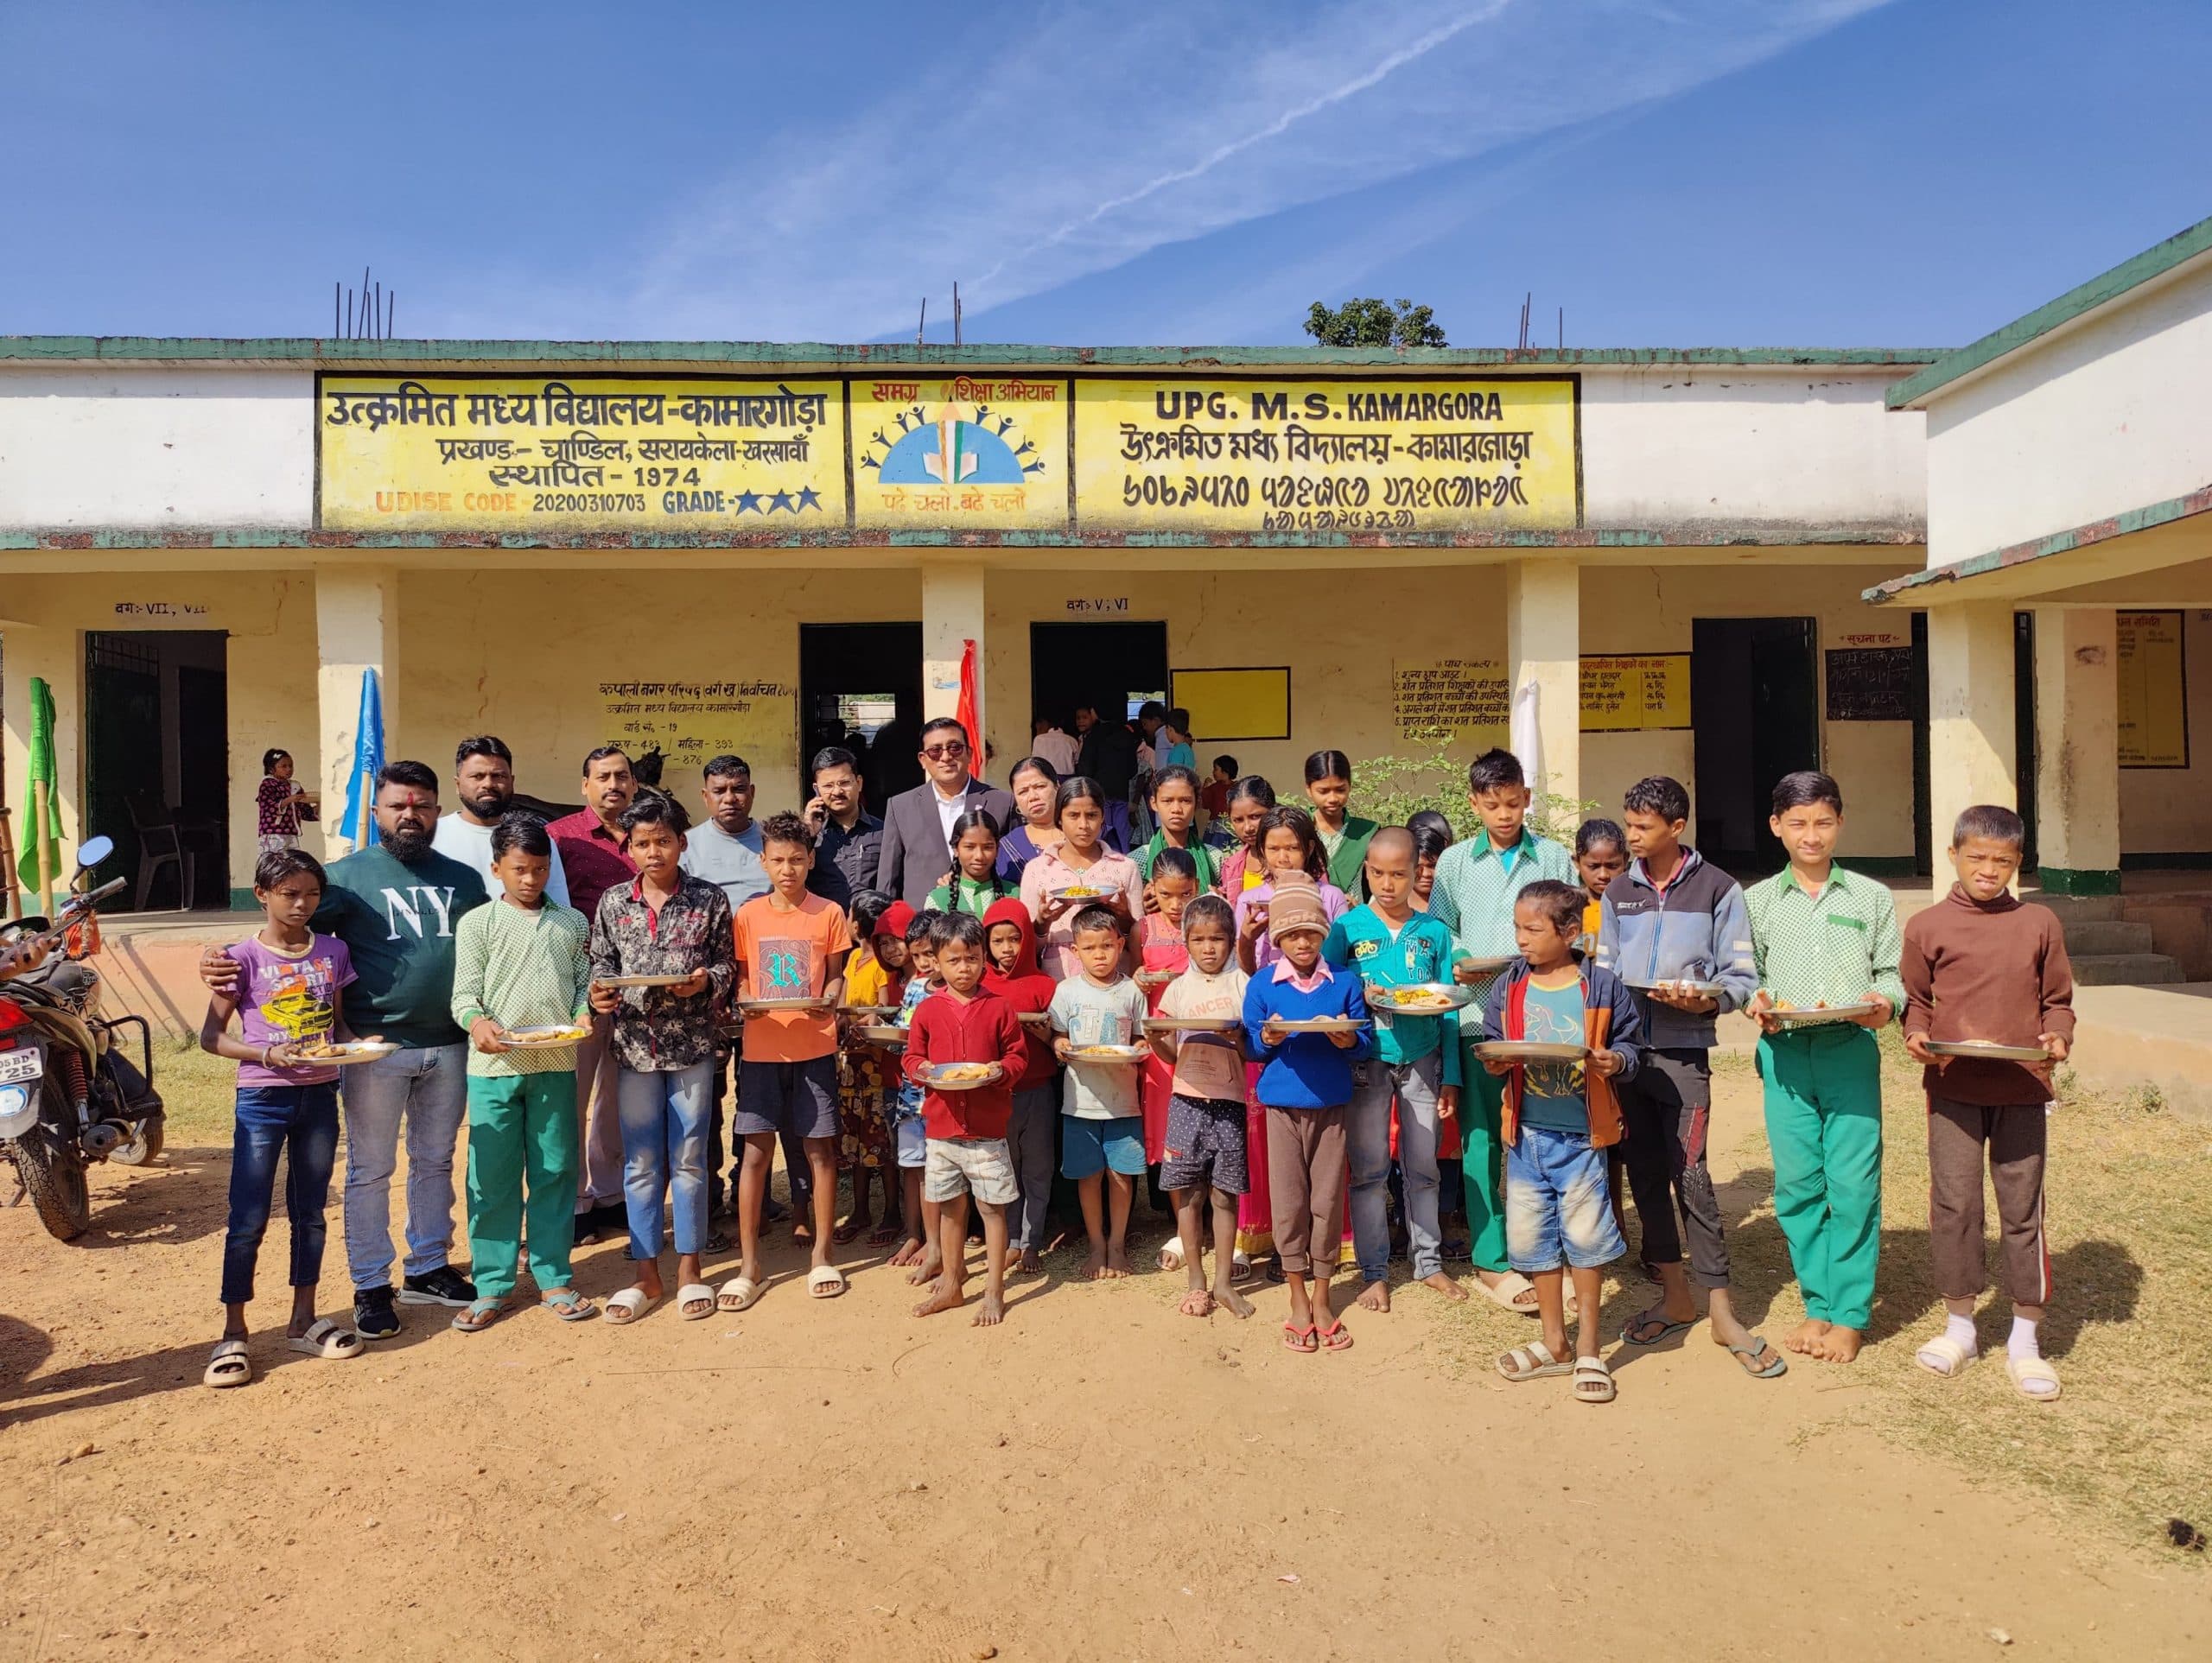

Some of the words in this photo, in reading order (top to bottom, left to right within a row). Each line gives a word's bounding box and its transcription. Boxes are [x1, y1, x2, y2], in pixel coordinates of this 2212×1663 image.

[872, 383, 920, 403] समग्र
[954, 376, 995, 404] शिक्षा
[996, 379, 1058, 403] अभियान
[327, 381, 459, 432] उत्क्रमित
[465, 394, 537, 426] मध्य
[1348, 392, 1503, 422] KAMARGORA
[1120, 422, 1225, 461] উৎক্রমিত
[1229, 428, 1279, 463] মধ্য
[634, 467, 701, 486] 1974
[376, 492, 452, 512] UDISE
[533, 493, 645, 512] 20200310703
[1114, 598, 1128, 610] VI
[641, 683, 664, 699] नगर
[624, 720, 639, 733] वार्ड
[669, 722, 677, 733] 19
[1440, 716, 1453, 726] का
[715, 739, 734, 749] 393
[683, 754, 702, 765] 876
[380, 885, 455, 940] NY
[0, 1063, 35, 1079] 25
